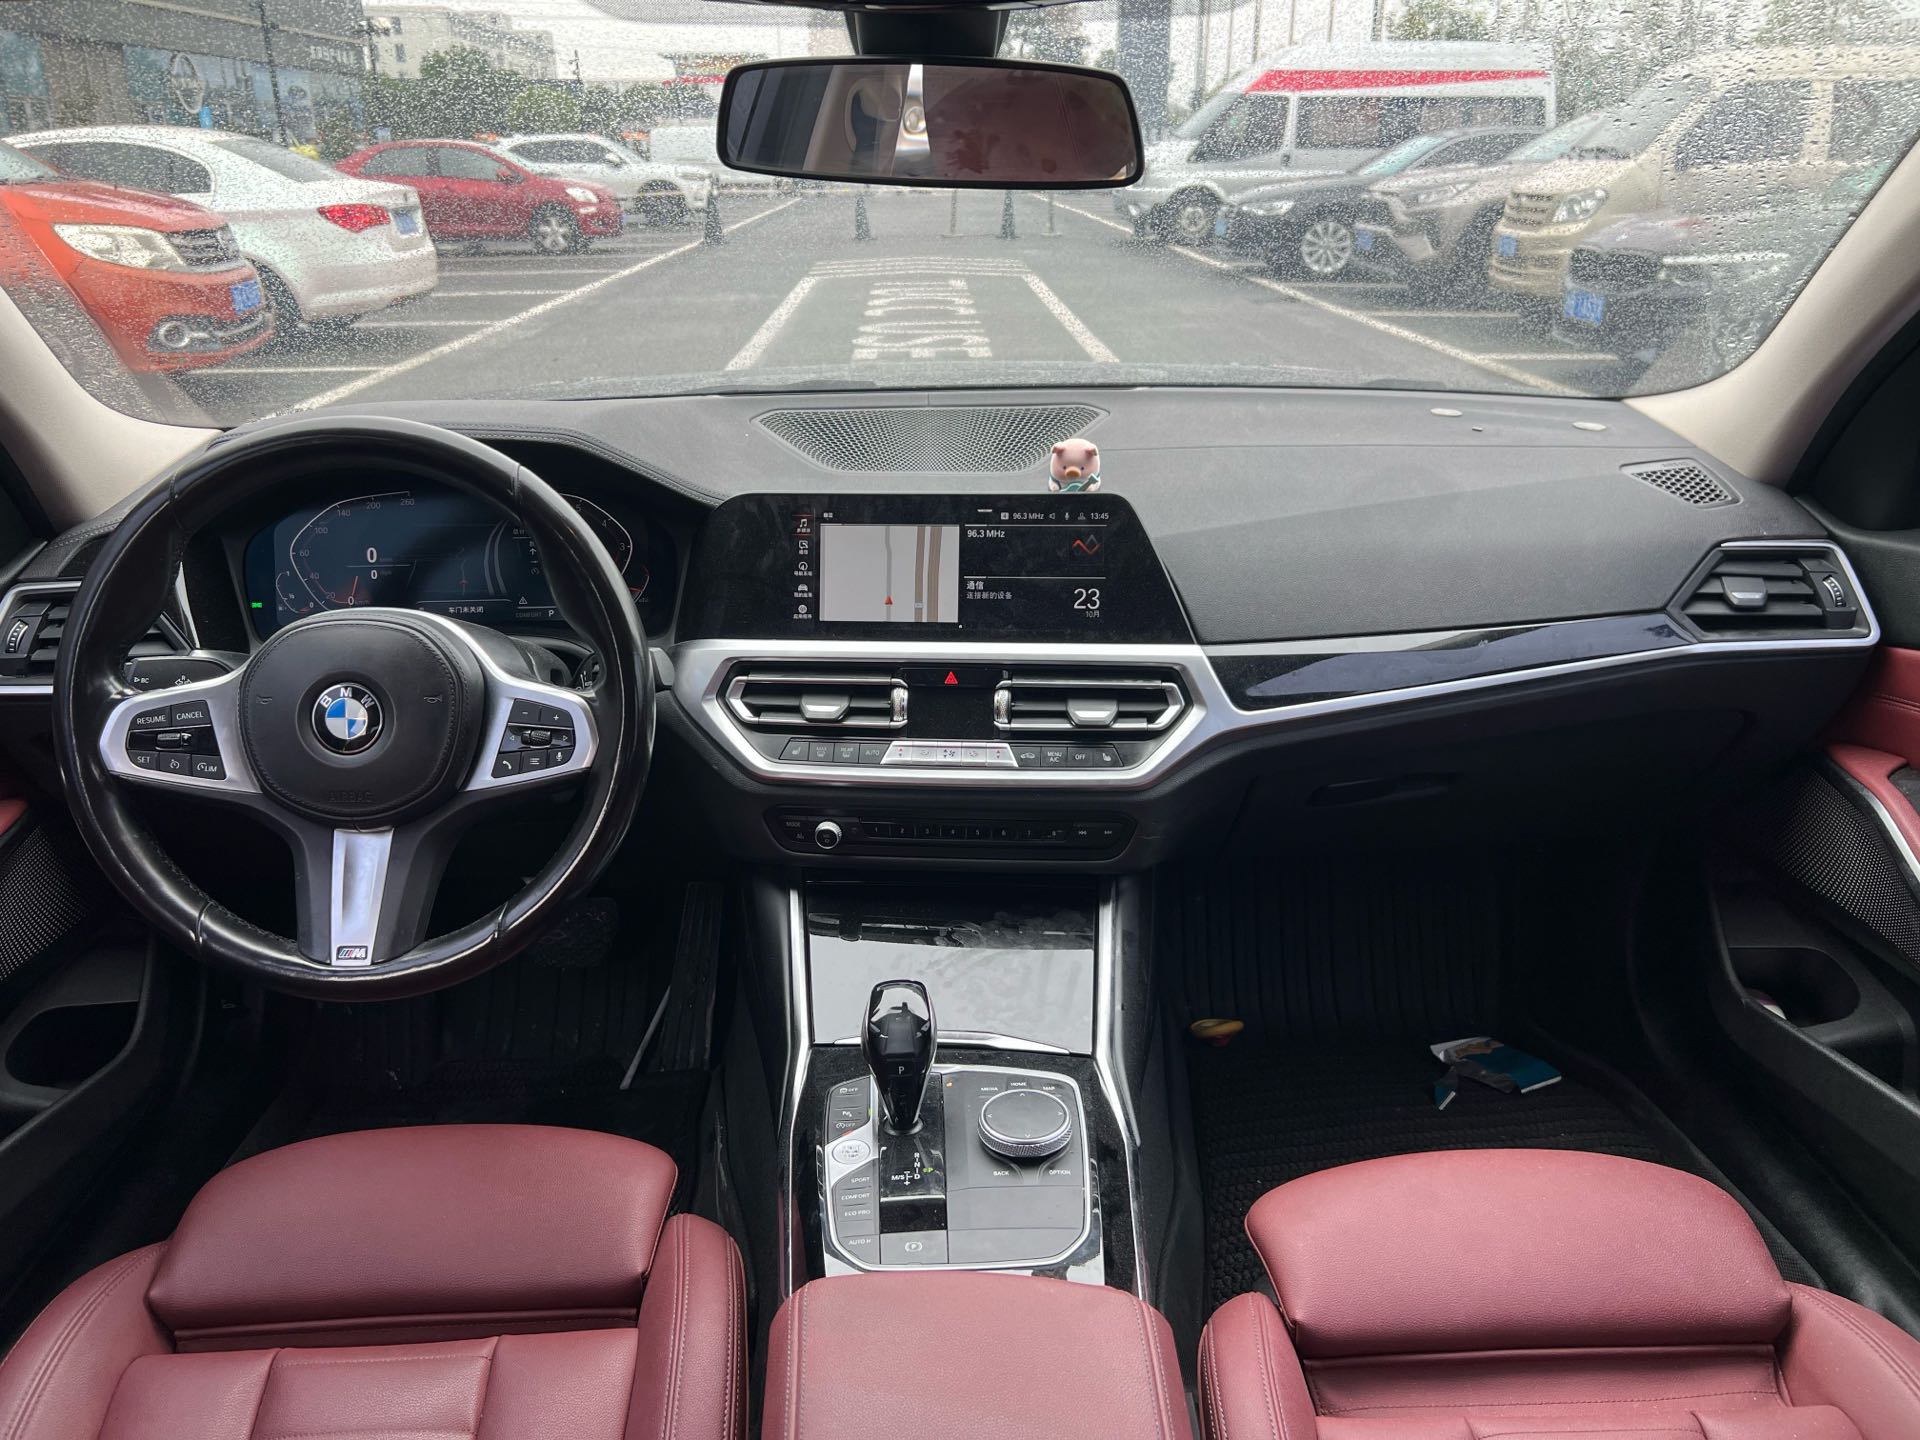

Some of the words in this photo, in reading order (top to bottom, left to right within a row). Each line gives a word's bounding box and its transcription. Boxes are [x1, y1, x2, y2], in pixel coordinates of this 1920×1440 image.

[366, 501, 381, 510] 200
[400, 498, 415, 506] 260
[337, 509, 351, 517] 140
[1012, 512, 1028, 520] 96.3
[1028, 512, 1045, 520] MHz
[1090, 512, 1110, 520] 13:45
[601, 519, 607, 528] 4
[967, 529, 985, 538] 96.3
[986, 529, 1005, 538] MHz
[619, 542, 626, 551] 3
[299, 549, 310, 557] 60
[366, 547, 377, 563] 0
[309, 572, 320, 580] 40
[370, 569, 378, 580] 0
[966, 581, 985, 590] 通信
[326, 591, 336, 599] 20
[966, 591, 1013, 600] 连接新的设备
[1073, 588, 1100, 609] 23
[347, 595, 355, 606] 0
[448, 605, 484, 614] 车门未关闭
[548, 609, 555, 617] P
[1085, 610, 1100, 618] 10月
[320, 687, 375, 709] BMW
[136, 714, 166, 725] RESUME
[176, 711, 204, 721] CANCEL
[137, 756, 150, 764] SET
[205, 765, 218, 773] LIM
[898, 1066, 905, 1075] P
[850, 1176, 870, 1184] SPORT
[841, 1193, 870, 1201] COMFORT
